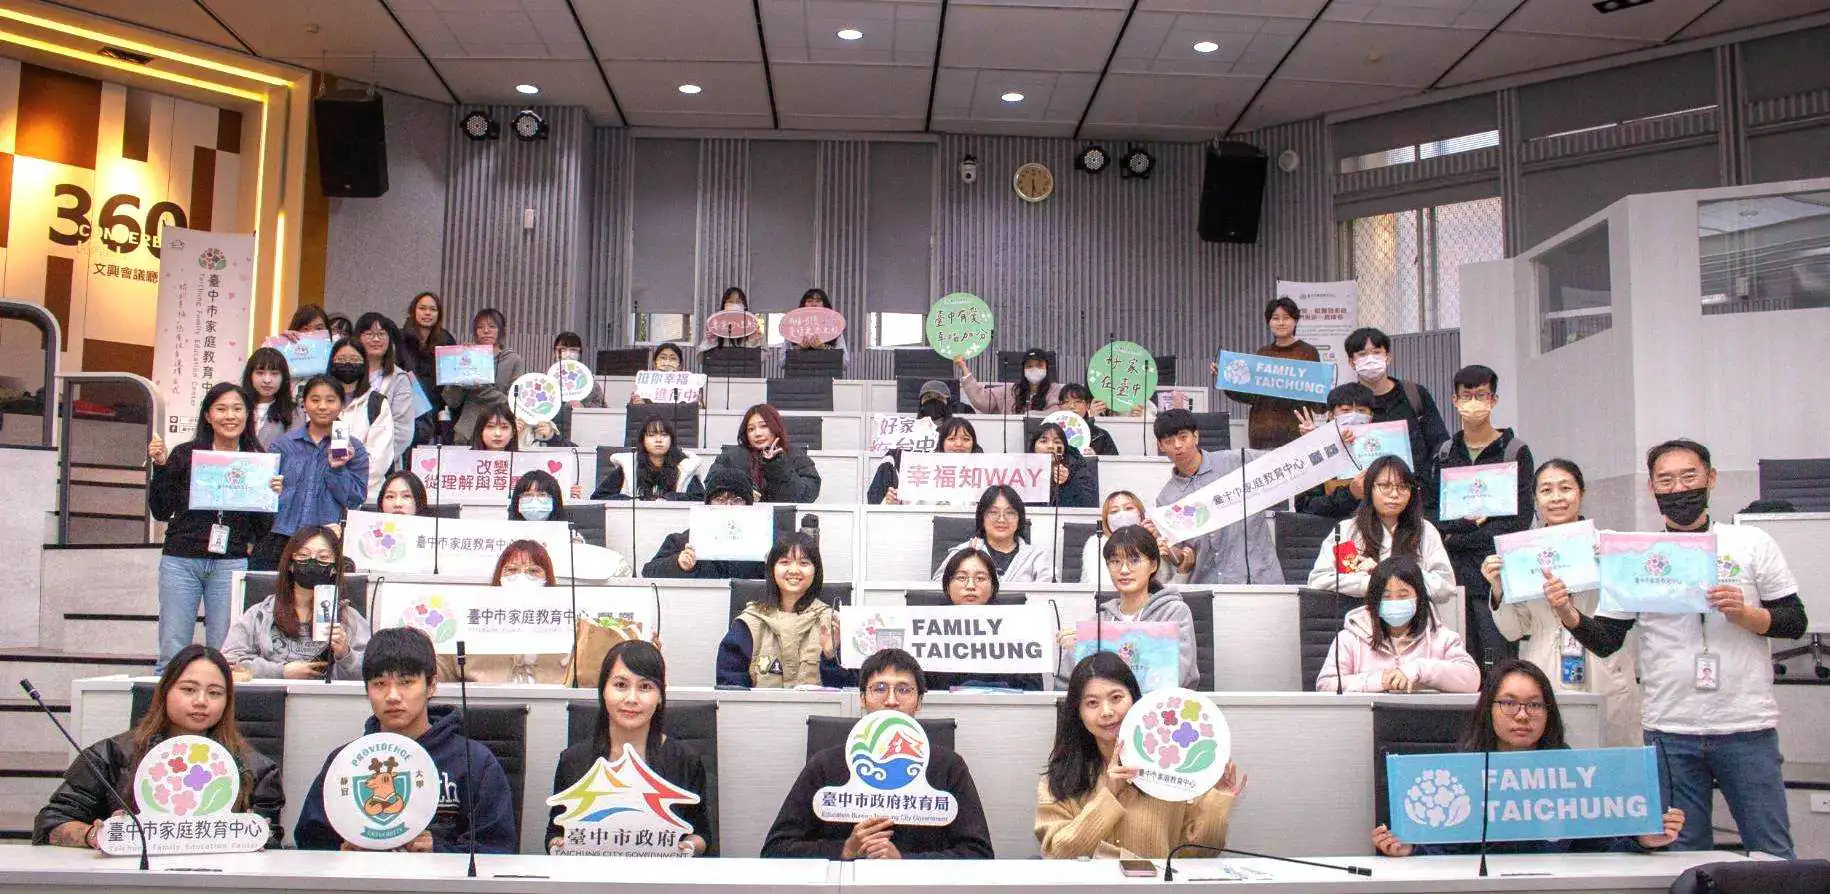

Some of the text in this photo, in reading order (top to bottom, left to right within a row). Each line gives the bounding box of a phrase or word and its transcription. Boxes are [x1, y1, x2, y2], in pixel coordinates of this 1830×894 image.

[49, 183, 188, 260] 360
[1255, 362, 1307, 378] FAMILY
[1255, 375, 1326, 395] TAICHUNG
[880, 417, 916, 435] 好家
[475, 459, 509, 476] 改變
[906, 464, 1044, 489] 幸福知WAY
[912, 618, 1003, 637] FAMILY
[911, 642, 1043, 660] TAICHUNG
[1481, 766, 1597, 792] FAMILY
[822, 791, 949, 812] 臺中市政府教育局
[1481, 795, 1649, 823] TAICHUNG
[107, 820, 262, 842] 臺中市家庭教育中心
[567, 827, 676, 847] 臺中市政府
